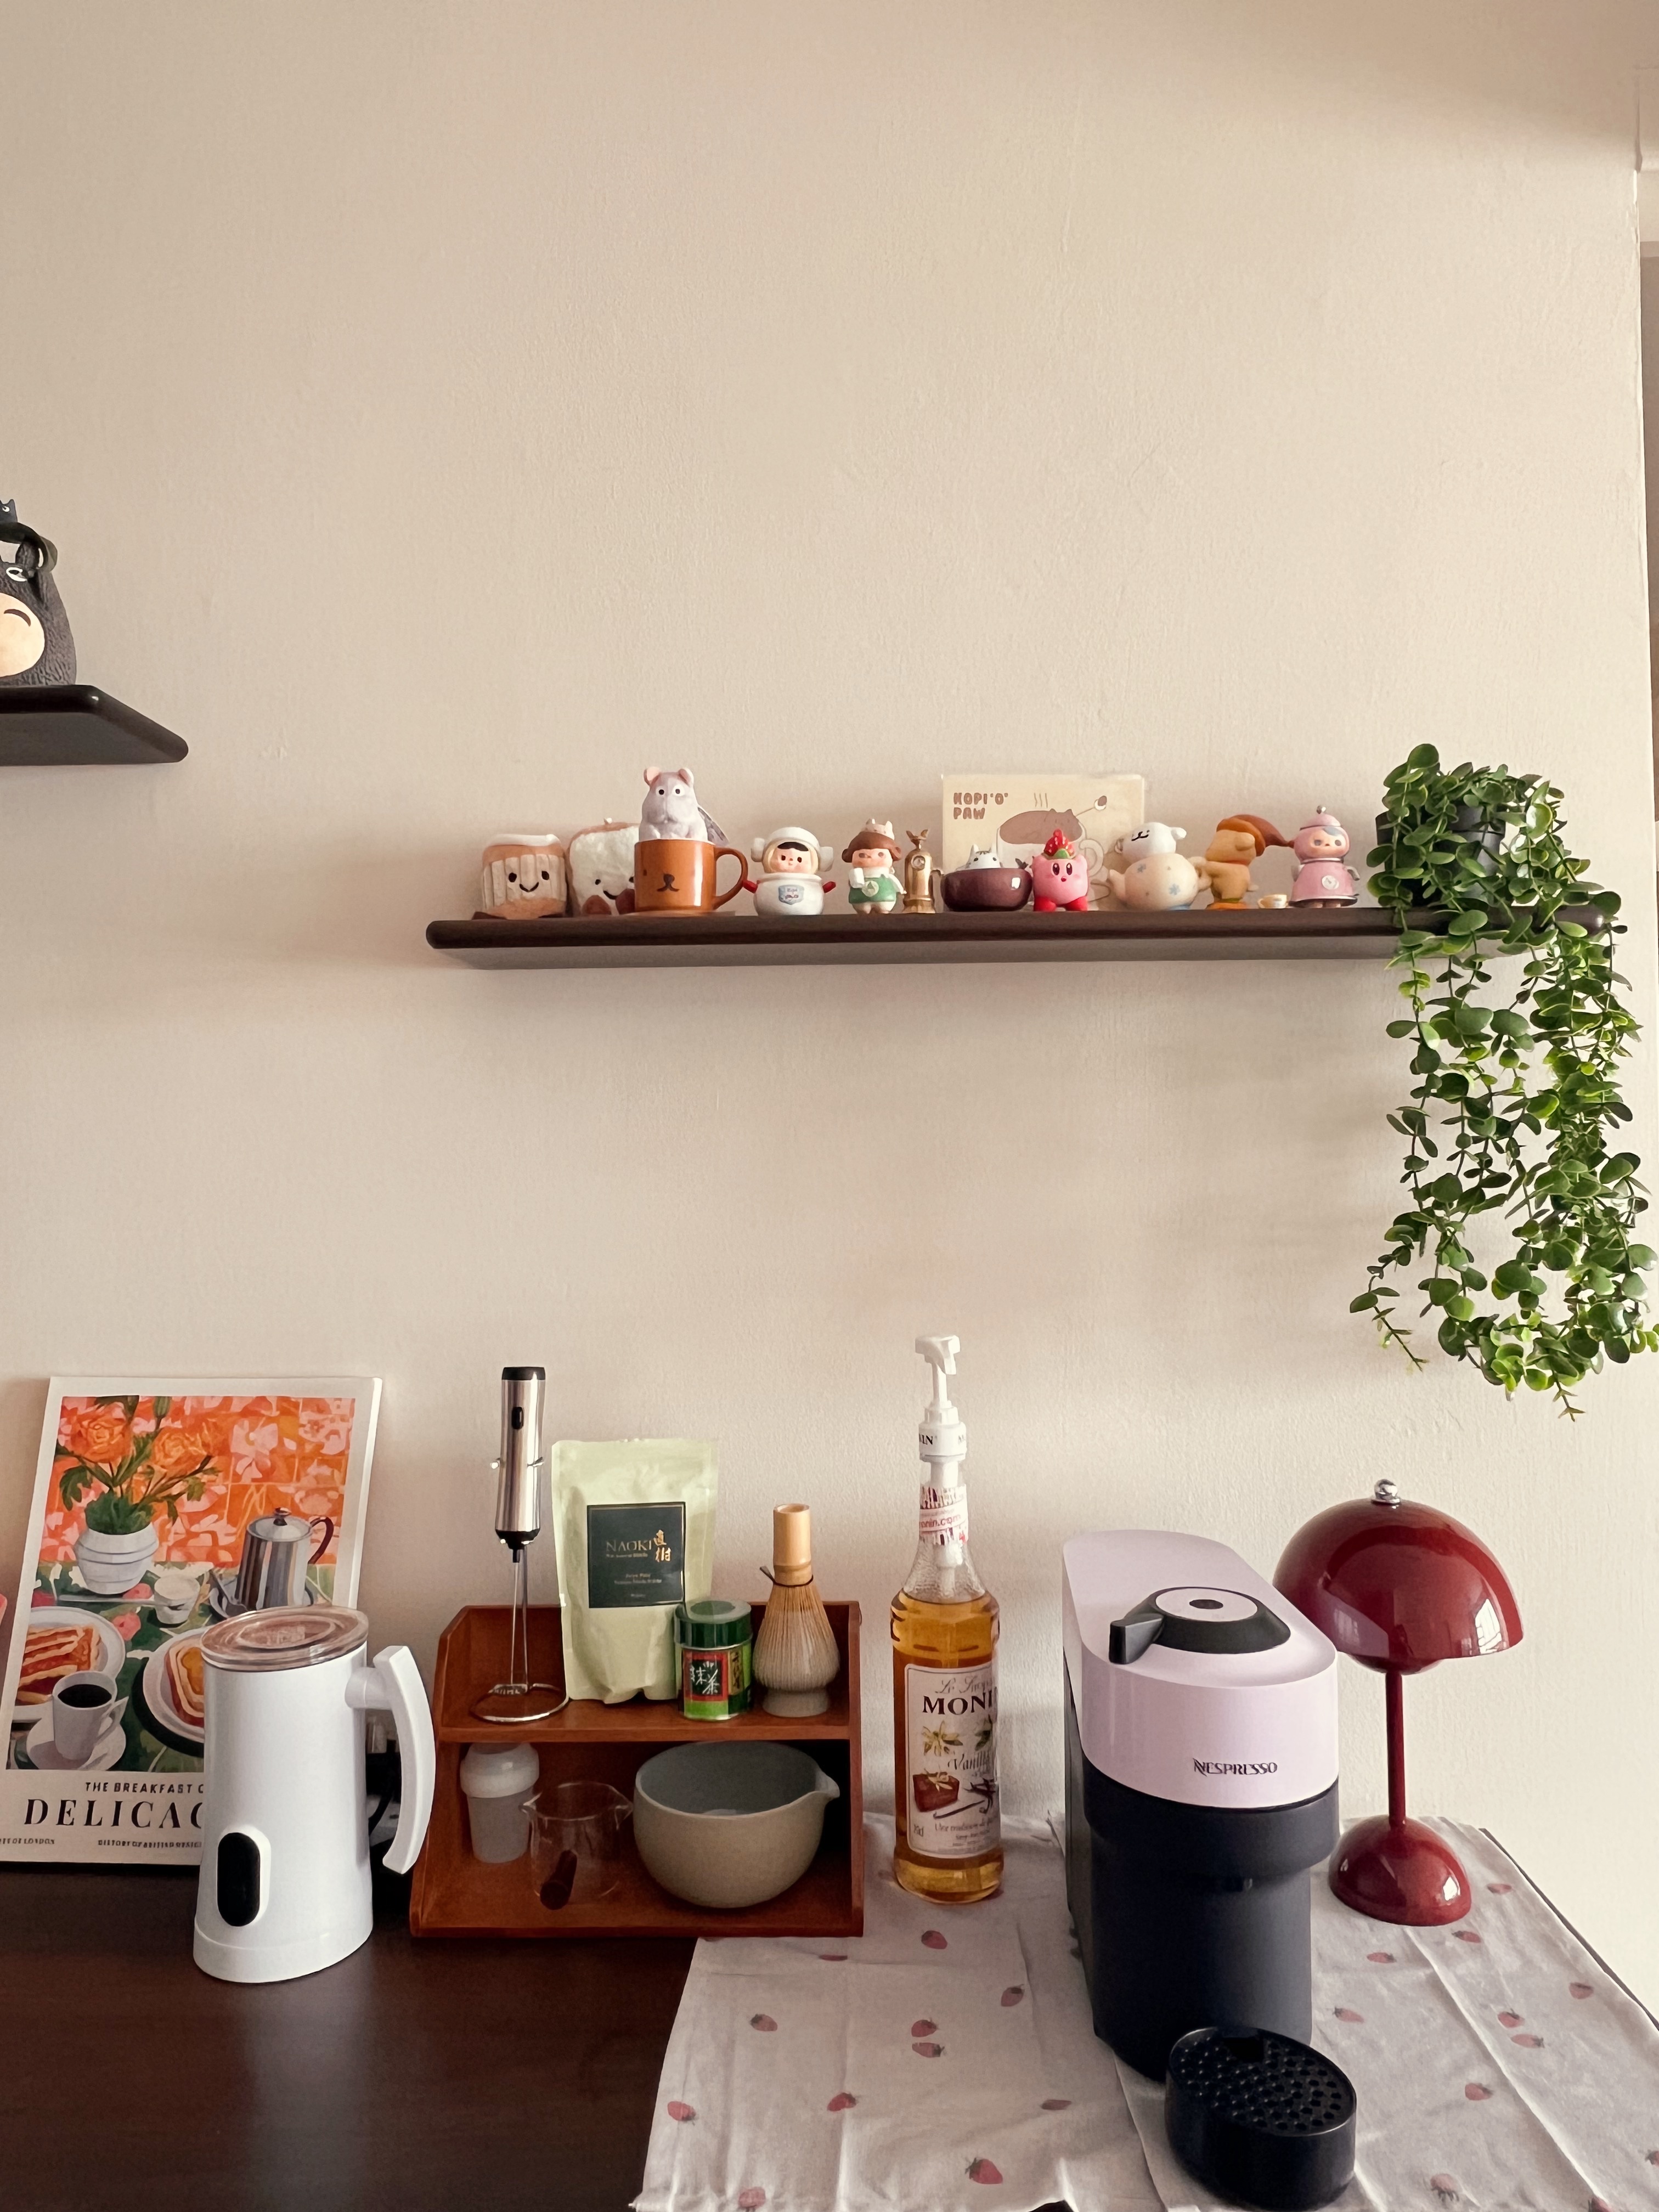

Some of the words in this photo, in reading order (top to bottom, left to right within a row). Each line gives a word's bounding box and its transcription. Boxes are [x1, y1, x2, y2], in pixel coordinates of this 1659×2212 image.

[953, 807, 985, 819] PAW
[606, 1540, 652, 1552] NAOKI
[1193, 1758, 1278, 1777] NESPRESSO
[86, 1782, 109, 1792] THE
[114, 1783, 193, 1794] BREAKFAST
